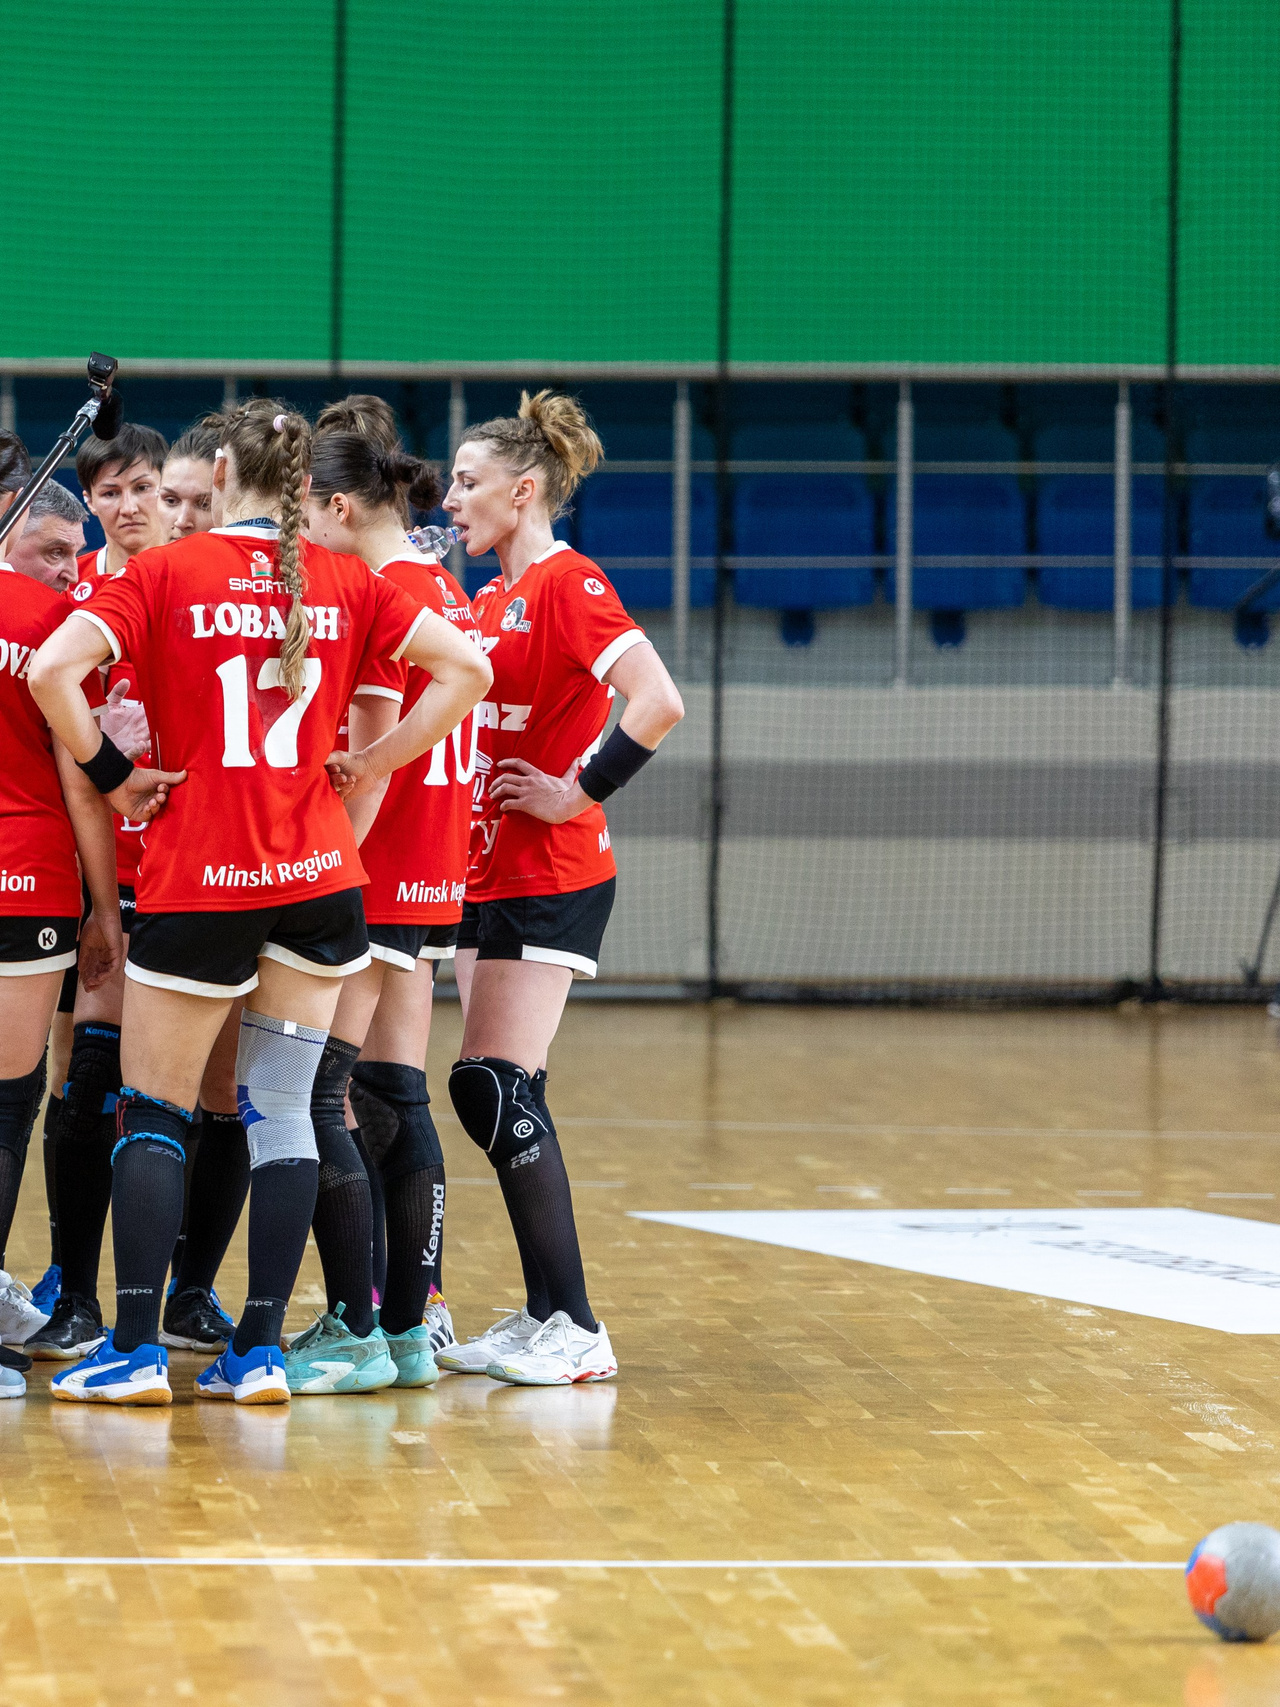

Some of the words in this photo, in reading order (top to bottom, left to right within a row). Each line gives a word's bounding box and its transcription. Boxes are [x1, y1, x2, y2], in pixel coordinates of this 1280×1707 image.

[229, 578, 303, 597] SPORTI
[215, 653, 322, 768] 17
[202, 862, 274, 888] Minsk
[276, 849, 343, 884] Region
[396, 879, 449, 903] Minsk
[85, 1026, 119, 1039] Kempa
[420, 1183, 445, 1267] Kempa
